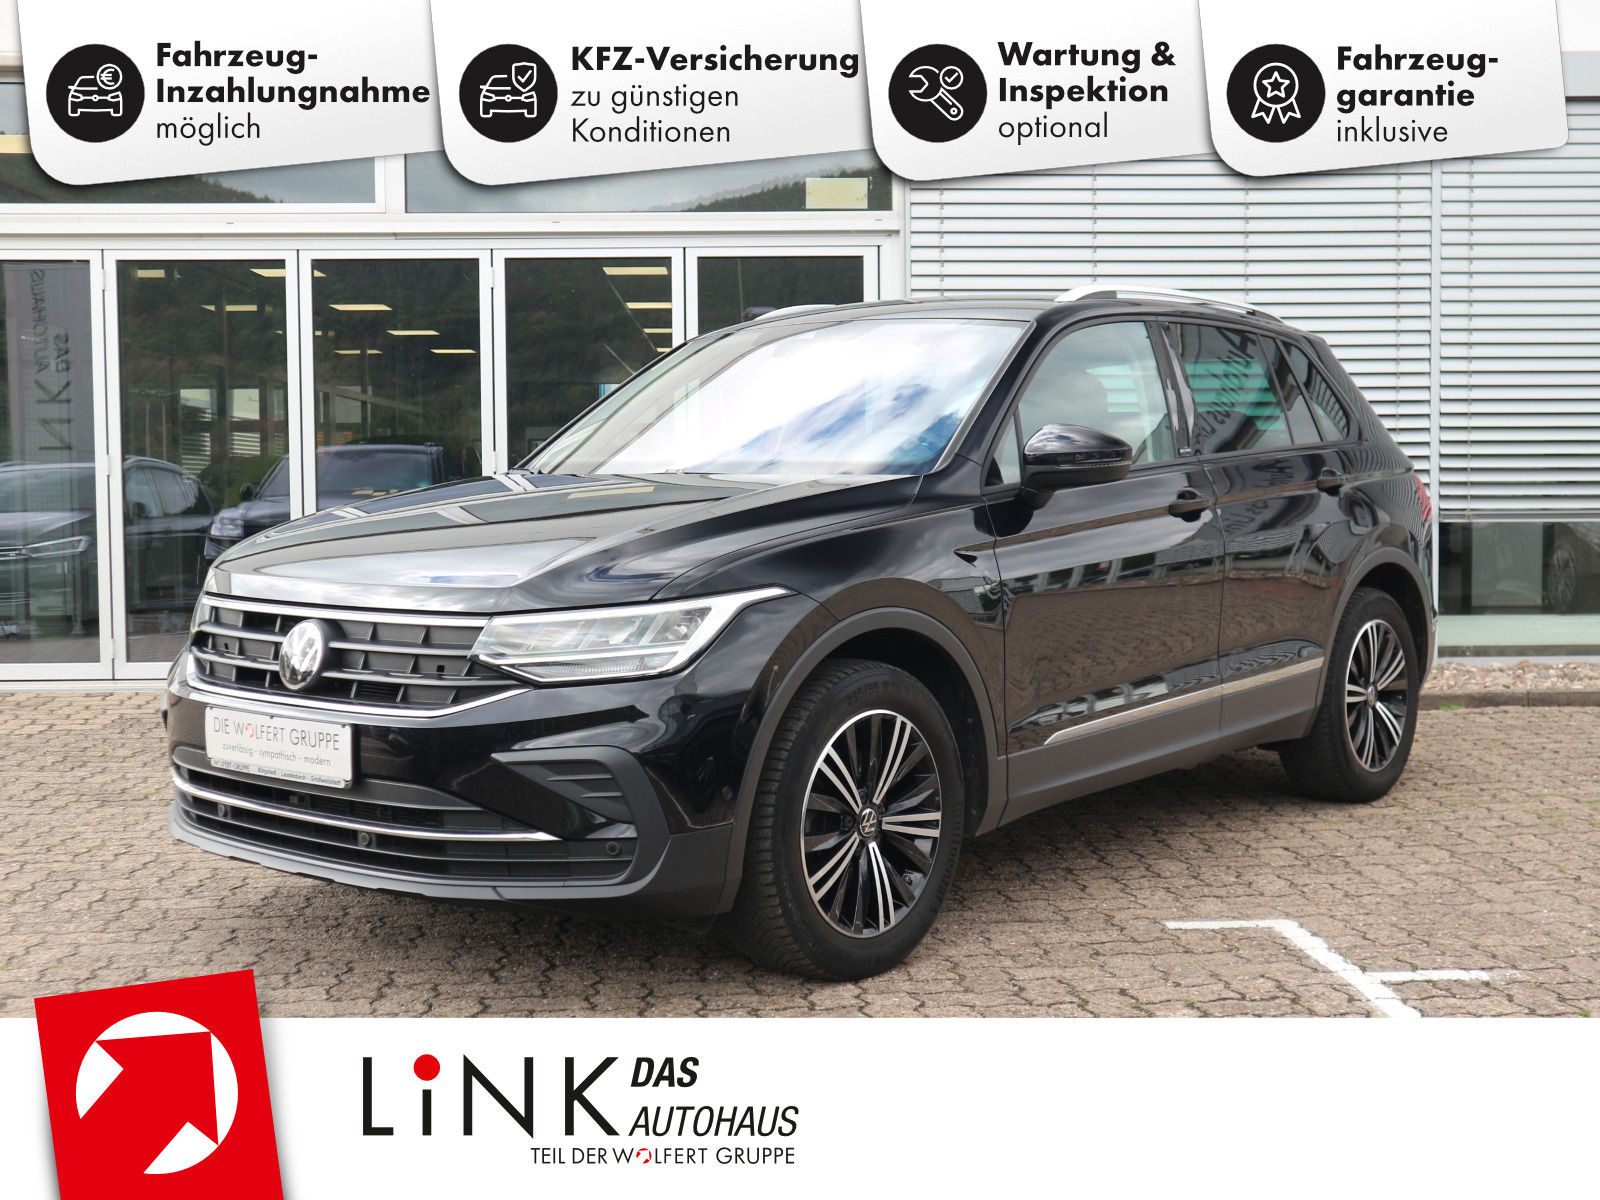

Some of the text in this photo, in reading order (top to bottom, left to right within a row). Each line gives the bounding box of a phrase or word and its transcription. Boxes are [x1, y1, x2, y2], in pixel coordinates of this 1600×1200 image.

[213, 716, 230, 735] DIE
[289, 728, 340, 751] GRUPPE
[258, 749, 297, 762] sympathisch
[303, 753, 331, 767] modern
